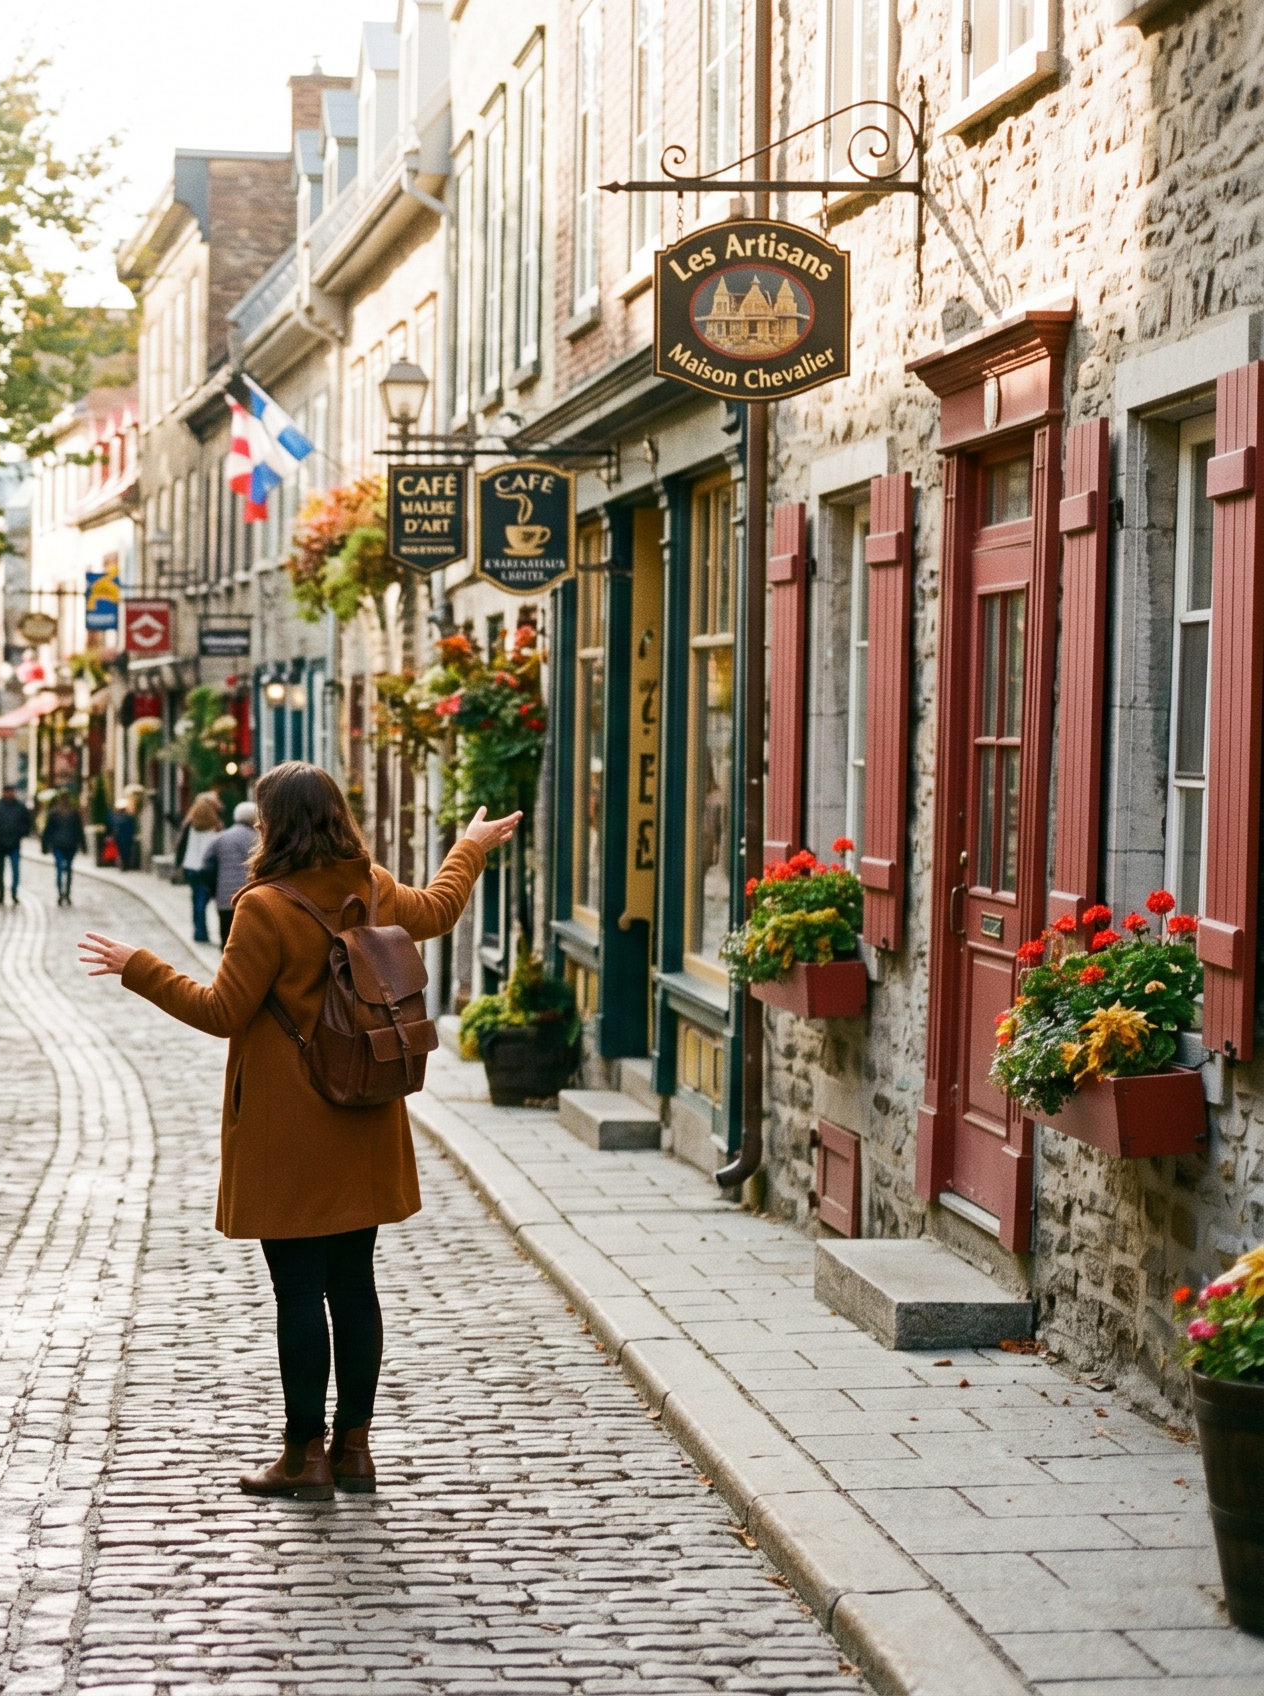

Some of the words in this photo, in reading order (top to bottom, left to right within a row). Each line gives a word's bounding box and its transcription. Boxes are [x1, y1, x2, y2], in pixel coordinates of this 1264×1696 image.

[668, 245, 717, 282] Les
[725, 232, 833, 282] Artisans
[668, 342, 737, 387] Maison
[743, 346, 835, 389] Chevalier
[397, 473, 457, 497] CAFÉ
[494, 473, 556, 495] CAFÉ
[404, 518, 451, 534] D'ART
